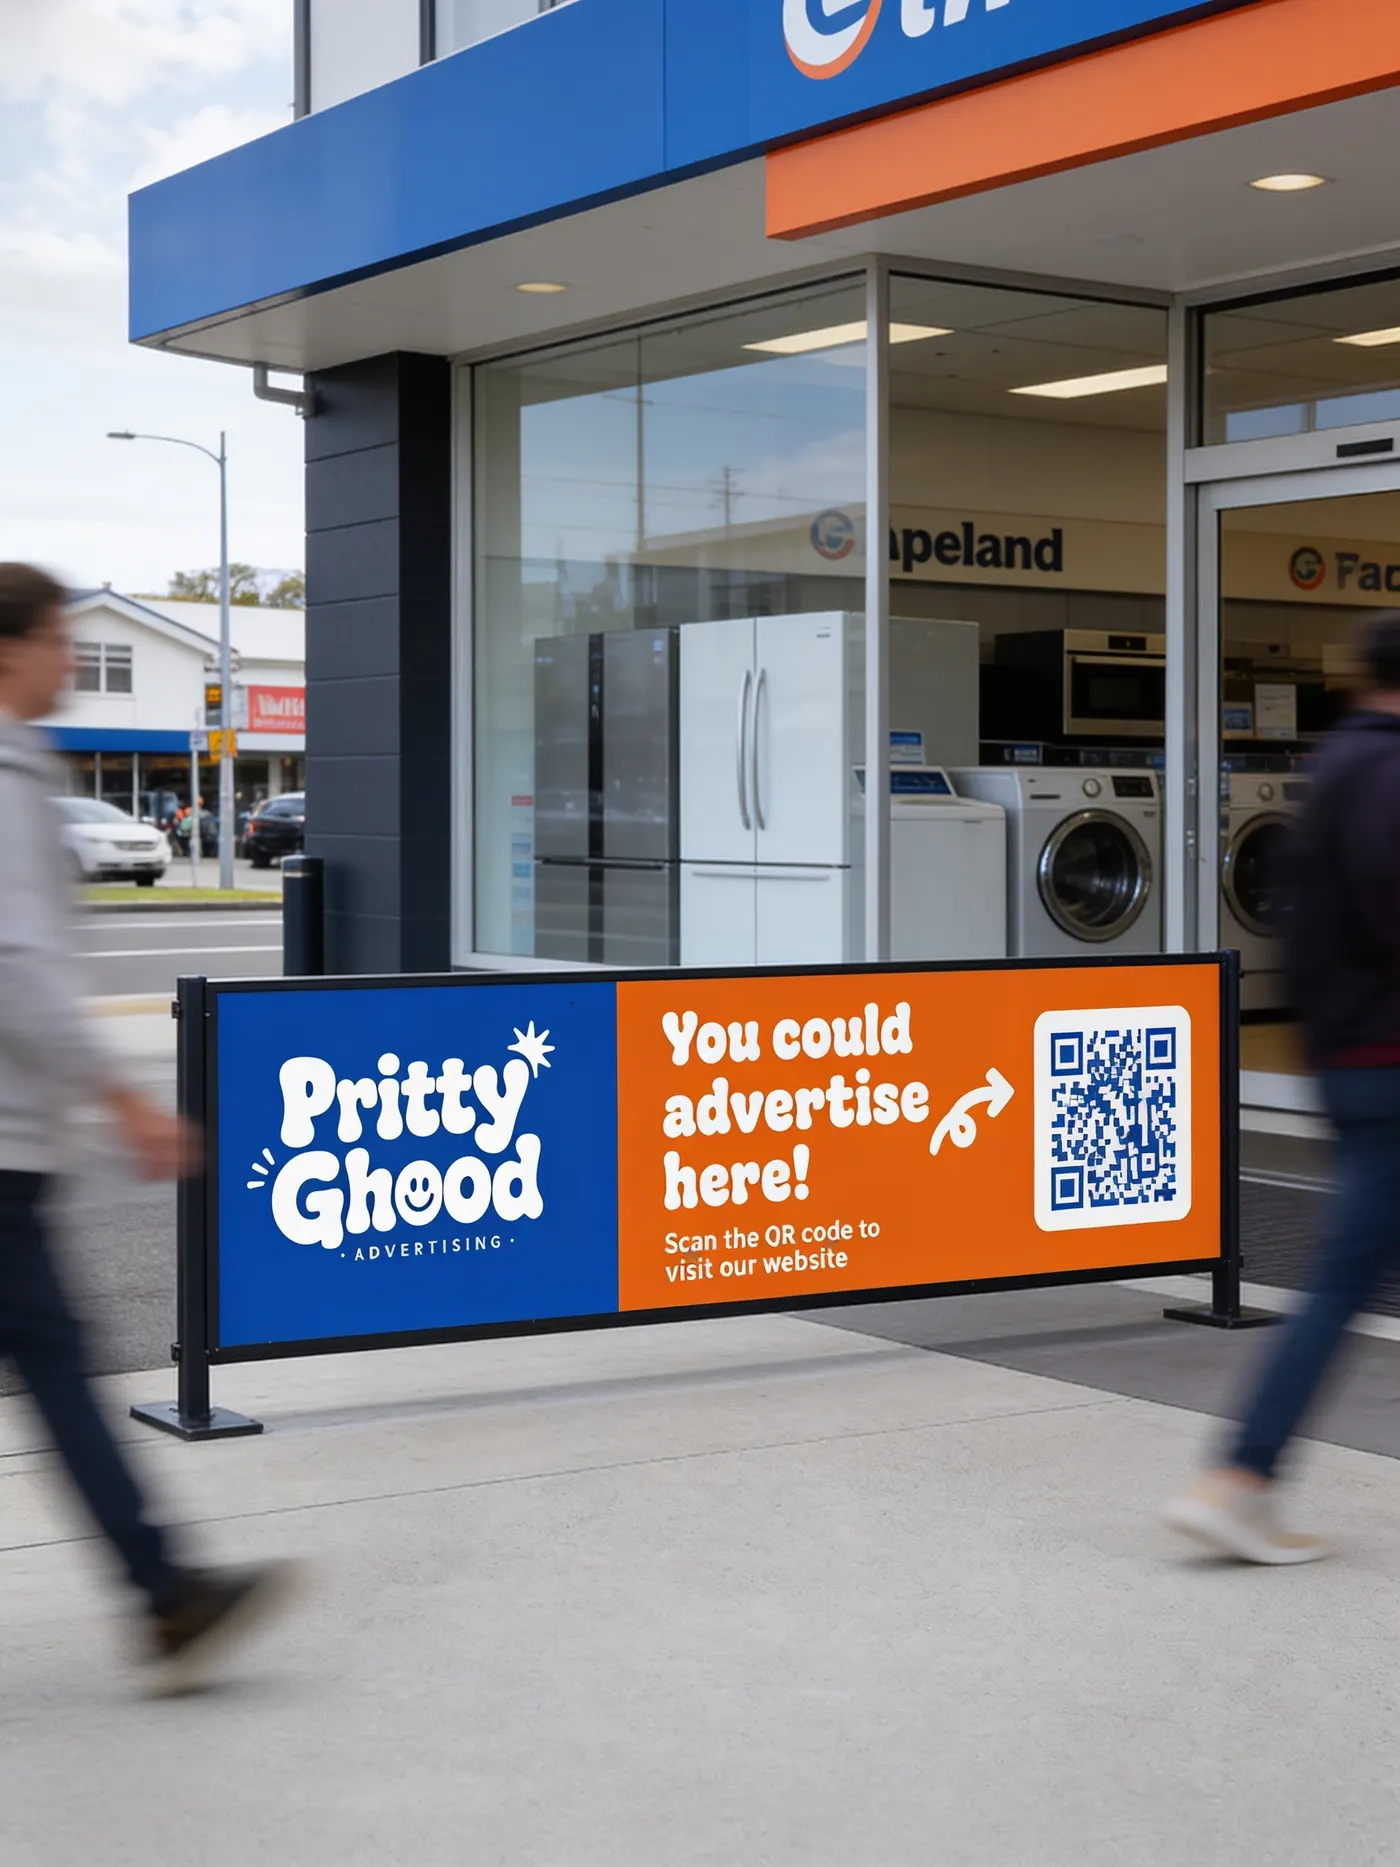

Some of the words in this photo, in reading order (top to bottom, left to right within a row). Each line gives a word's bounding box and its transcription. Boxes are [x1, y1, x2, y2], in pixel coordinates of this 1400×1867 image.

[661, 1010, 761, 1066] You
[772, 1001, 913, 1061] could
[279, 1052, 530, 1154] Pritty
[662, 1067, 929, 1139] advertise
[271, 1133, 544, 1250] Ghood
[663, 1143, 810, 1211] here!
[354, 1235, 502, 1262] ADVERTISING
[664, 1231, 717, 1254] Scan
[723, 1227, 760, 1249] the
[801, 1219, 854, 1243] code
[858, 1219, 880, 1239] to
[665, 1257, 714, 1283] visit
[719, 1259, 757, 1278] our
[762, 1247, 849, 1275] website
